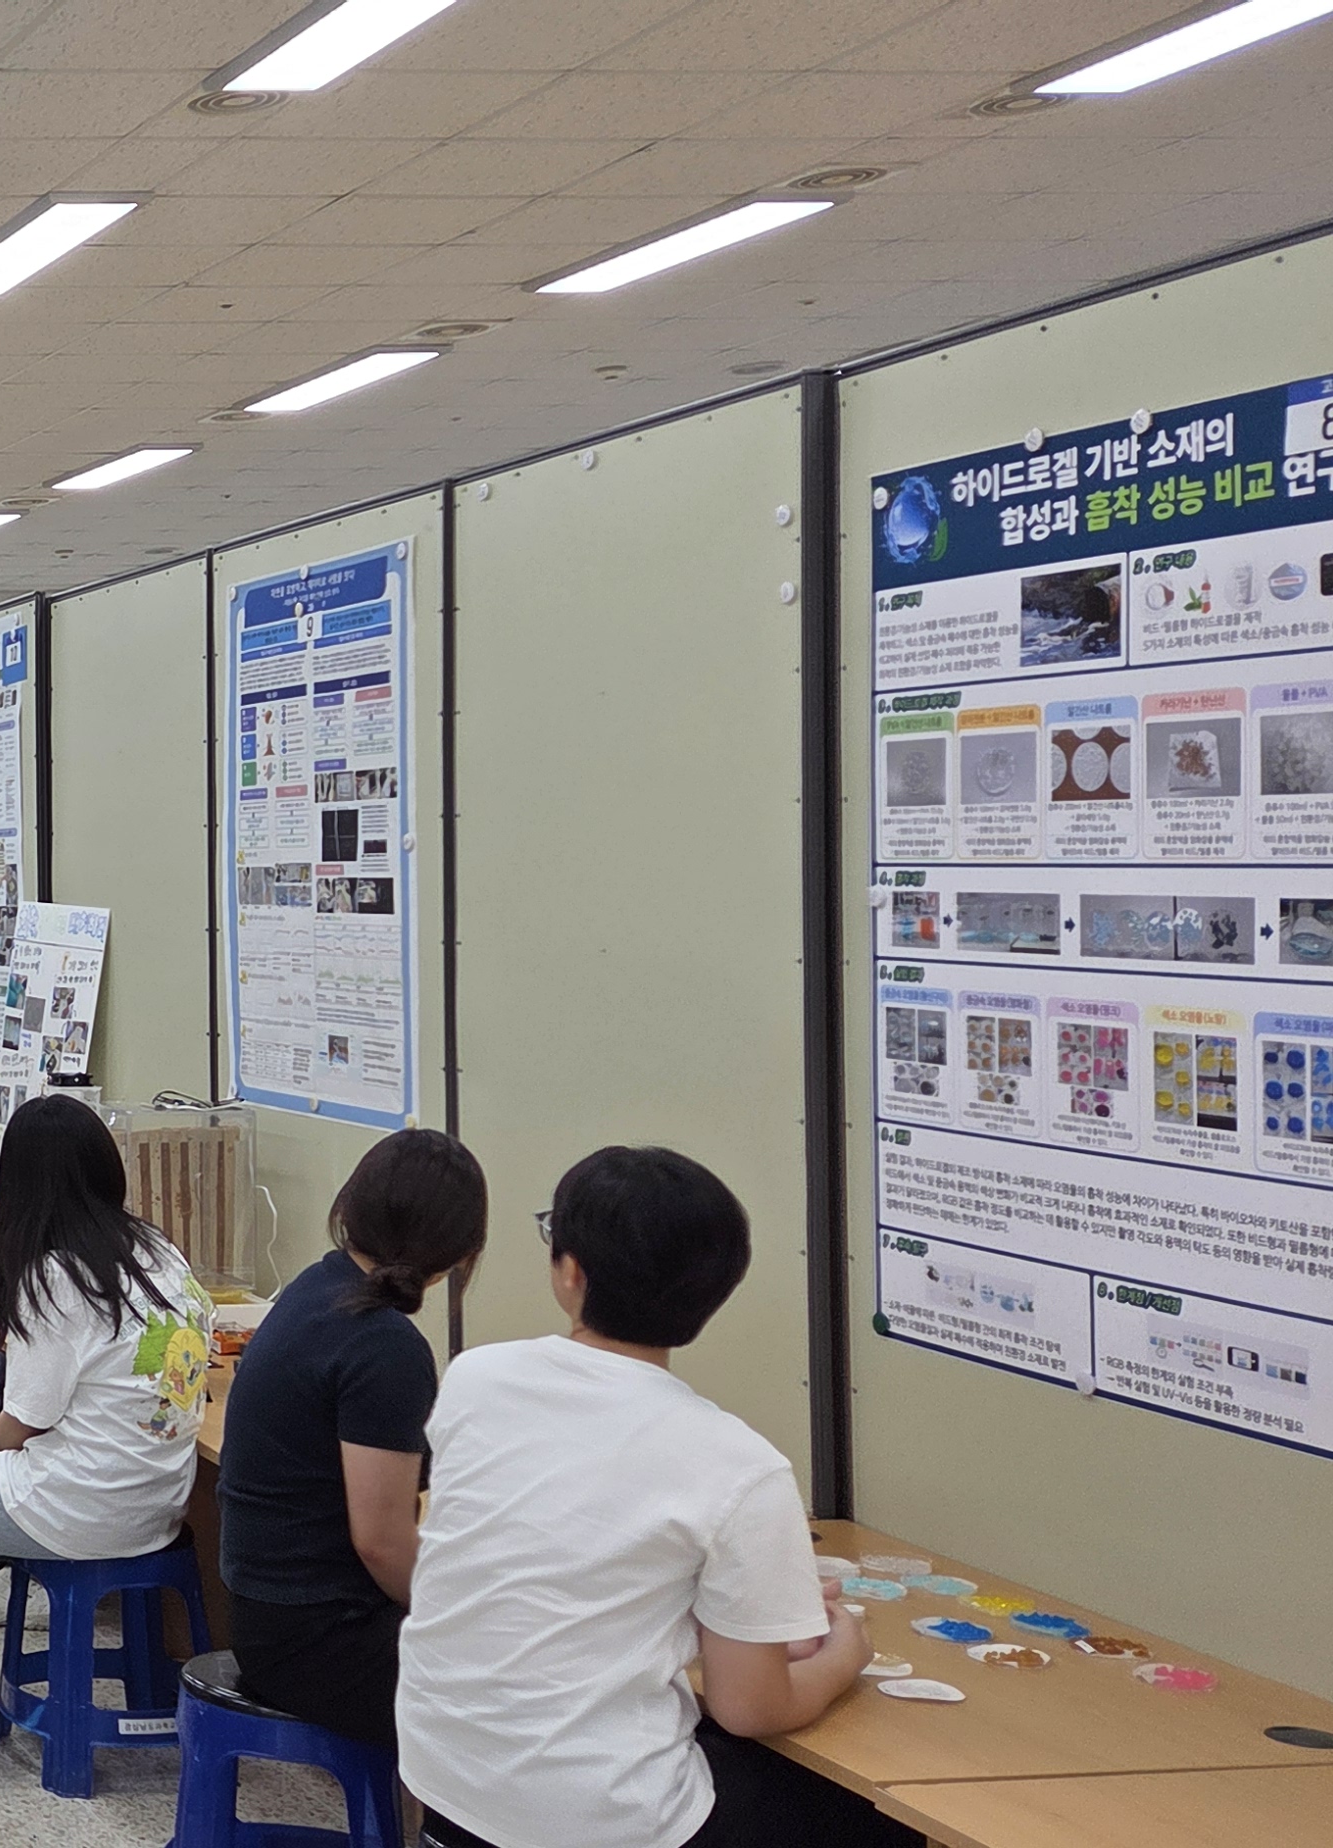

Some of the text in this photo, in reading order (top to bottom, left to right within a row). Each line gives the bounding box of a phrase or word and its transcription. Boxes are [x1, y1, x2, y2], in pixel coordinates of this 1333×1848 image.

[950, 412, 1234, 507] 하이드로겔 기반 소재의
[999, 495, 1080, 546] 합성과
[1085, 484, 1141, 532] 흡착
[1147, 474, 1206, 520] 성능
[1214, 461, 1275, 507] 비교
[306, 616, 314, 638] 9
[1269, 1218, 1308, 1236] 키토산을
